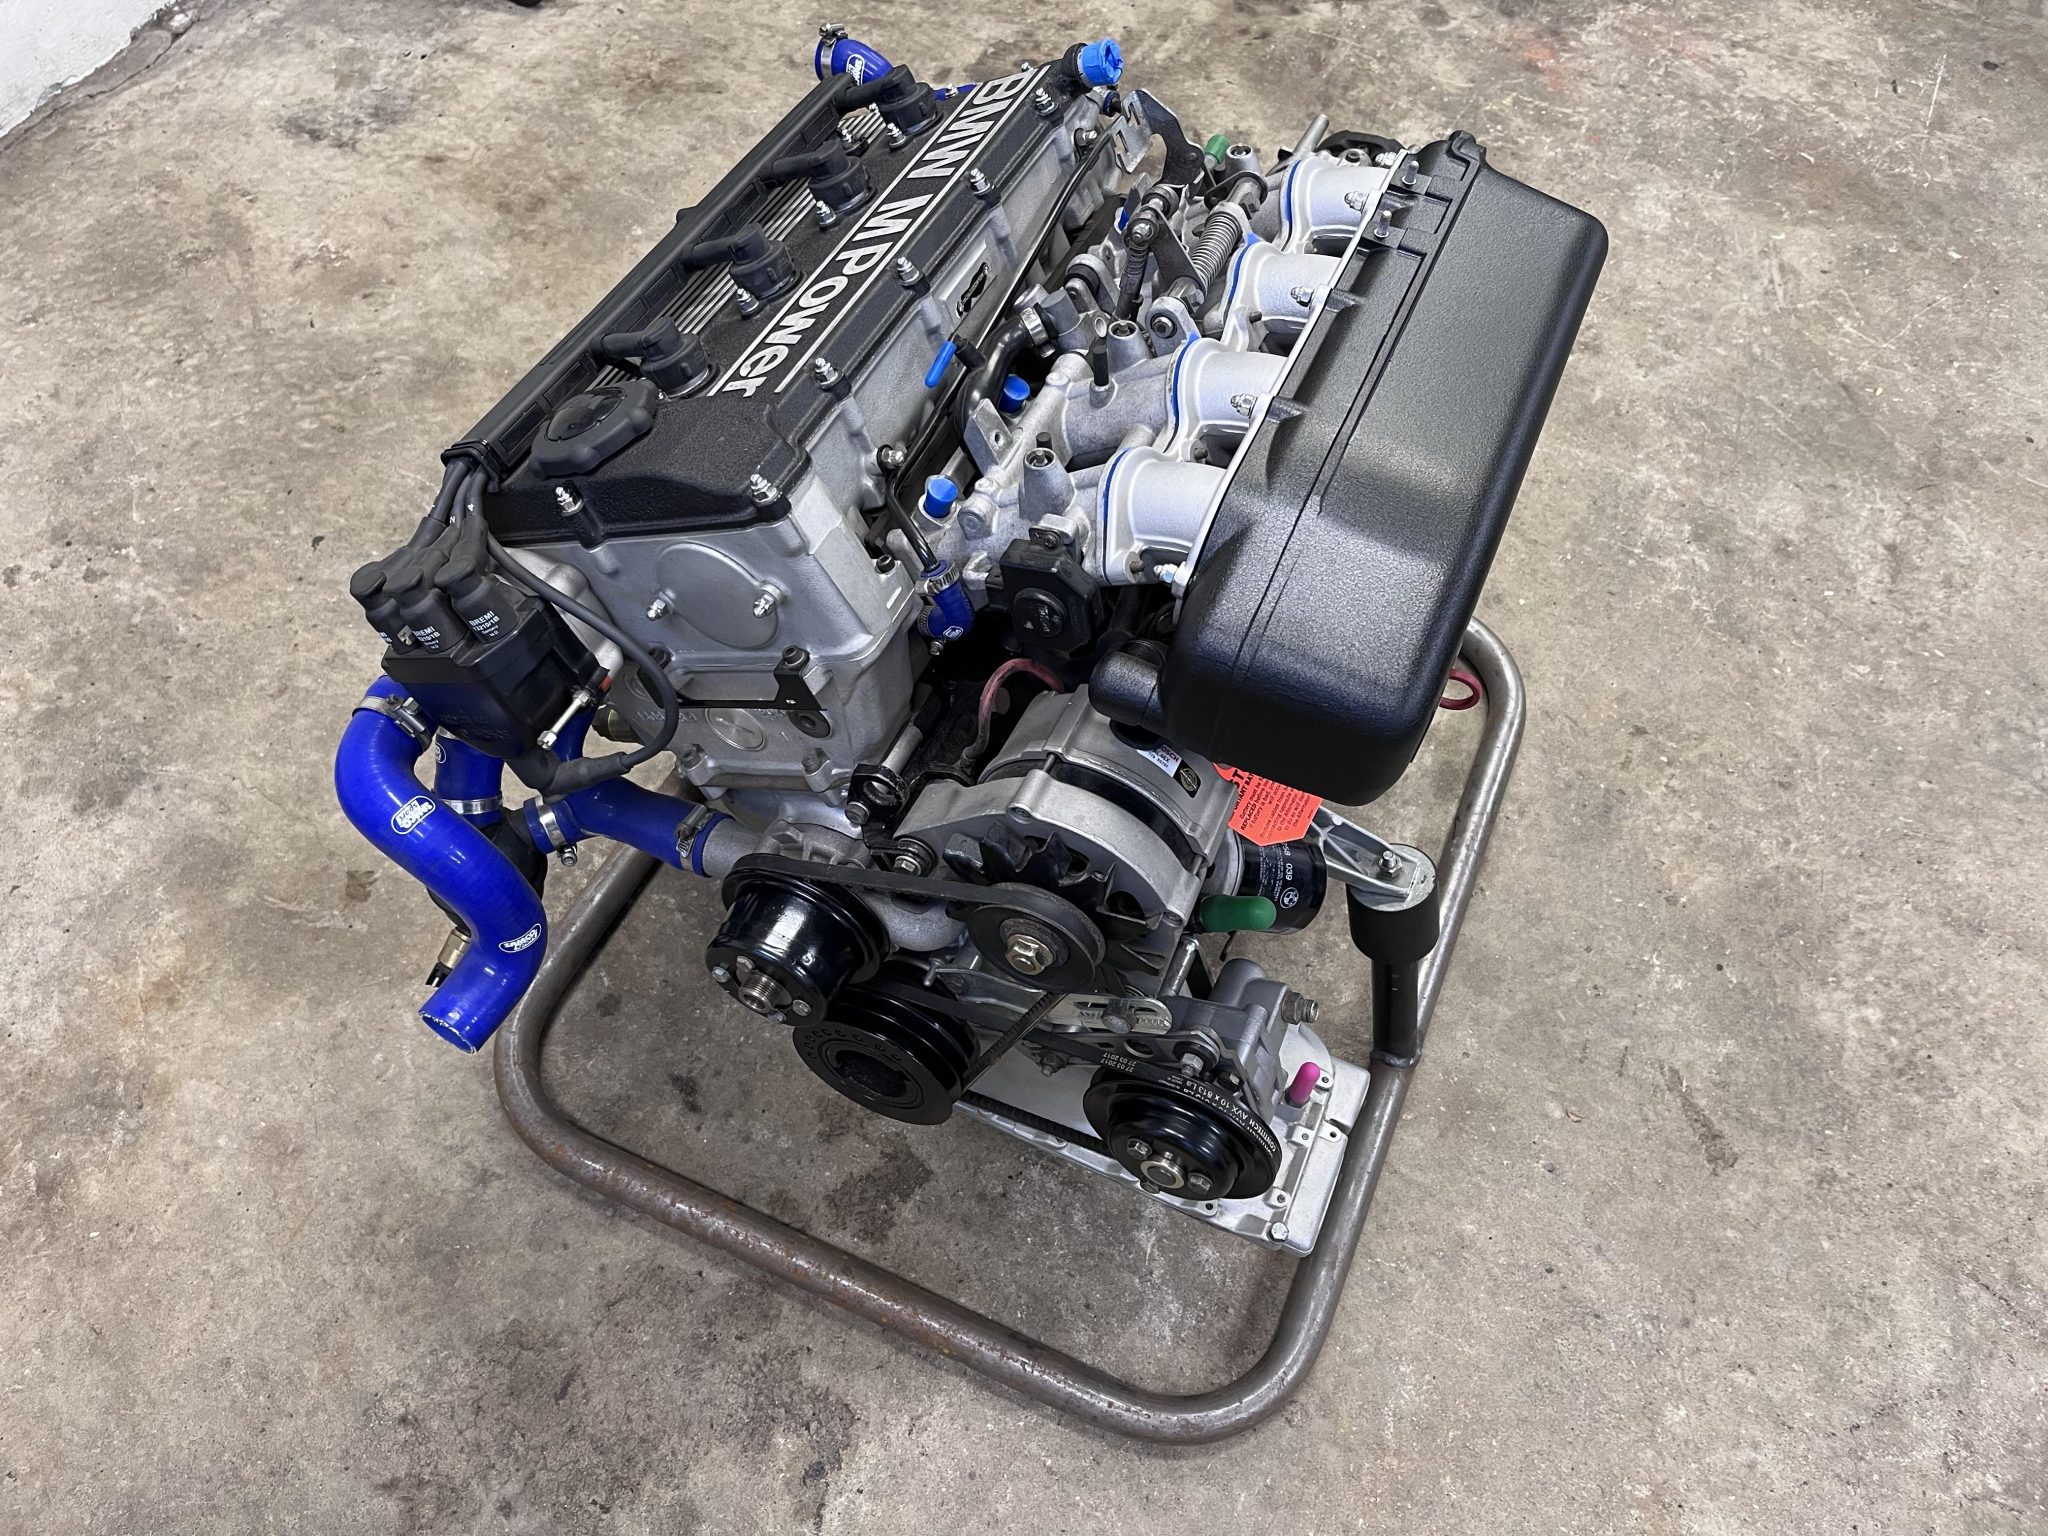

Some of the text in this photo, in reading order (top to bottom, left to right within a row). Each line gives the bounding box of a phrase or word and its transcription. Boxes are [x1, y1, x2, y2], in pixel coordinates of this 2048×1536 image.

[907, 71, 1034, 179] BMW
[469, 611, 494, 626] BREMI
[1161, 746, 1179, 762] OSCH
[1241, 803, 1256, 830] REPLACED
[1100, 1058, 1117, 1066] 2017
[1103, 1052, 1119, 1060] 2017
[1220, 1098, 1229, 1108] 10
[1231, 1105, 1248, 1119] AVX
[1249, 1119, 1276, 1151] CONTITECH
